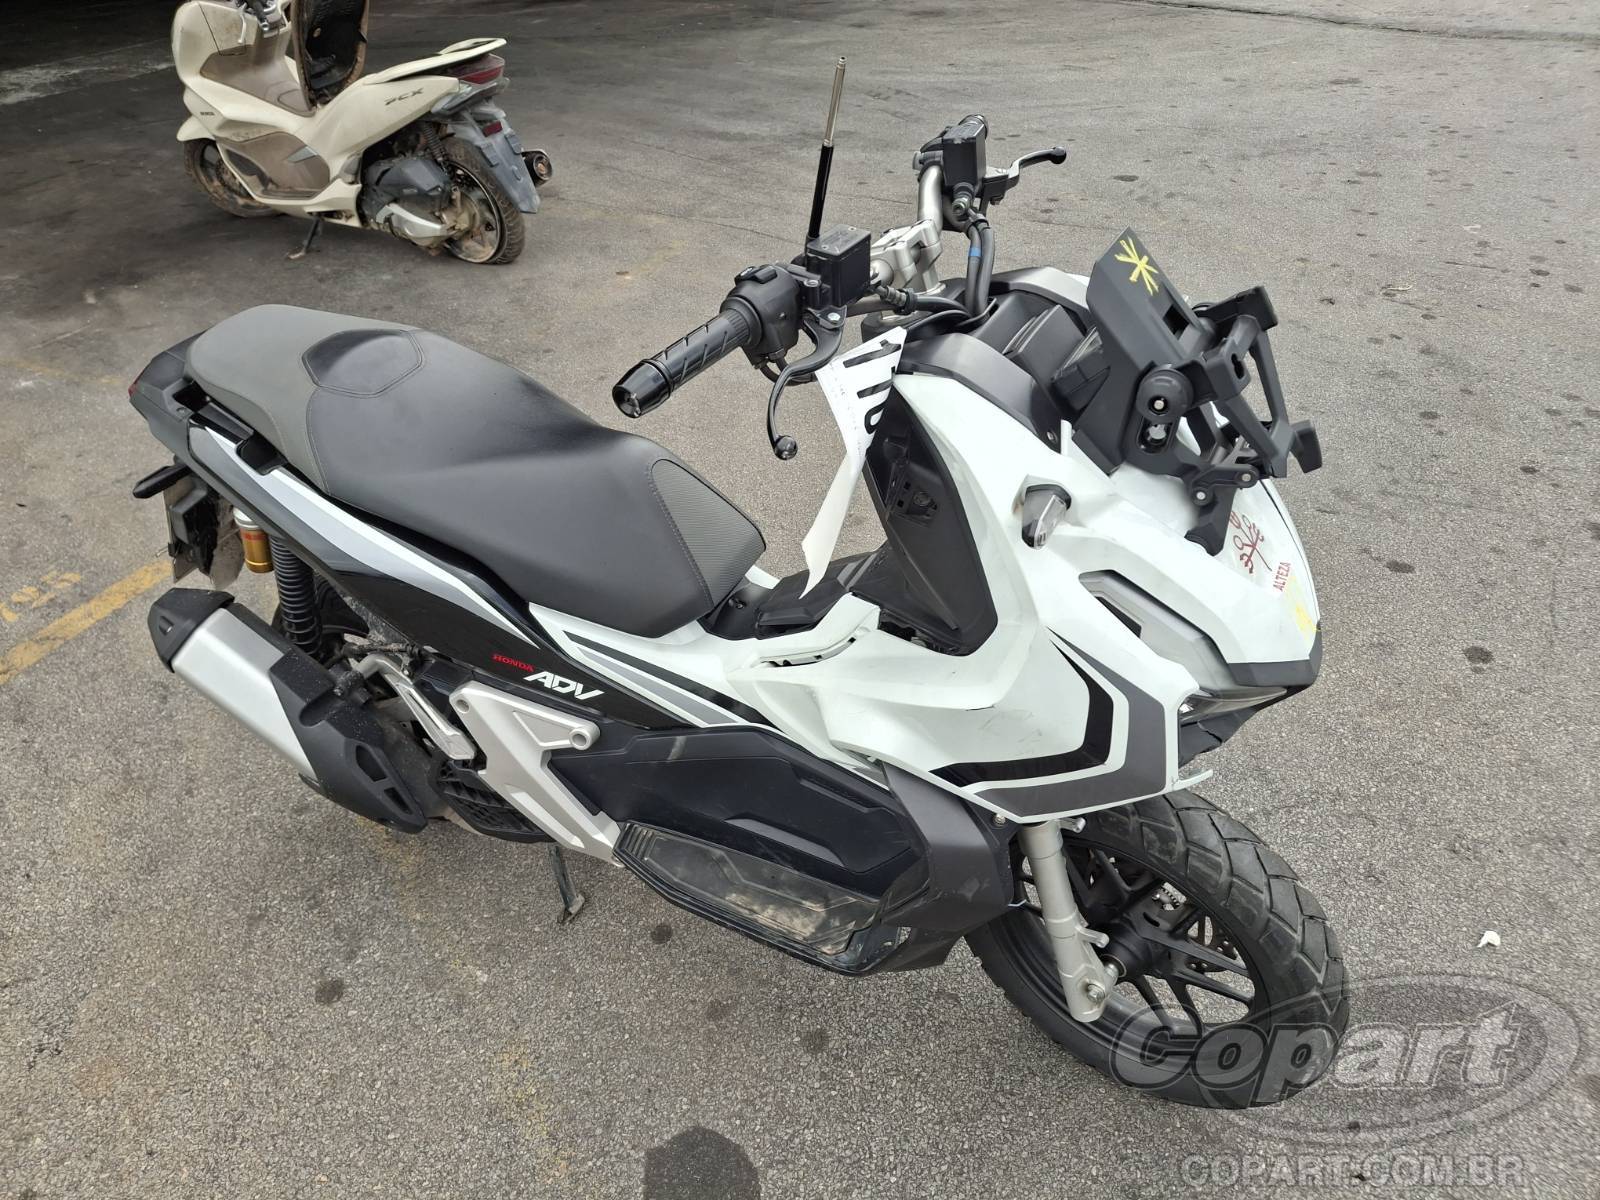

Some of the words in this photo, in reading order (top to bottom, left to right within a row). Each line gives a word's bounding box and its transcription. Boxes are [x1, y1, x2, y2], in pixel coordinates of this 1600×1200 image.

[1272, 561, 1292, 592] ALTEZA
[492, 654, 534, 673] HONDA
[523, 670, 605, 700] ADV
